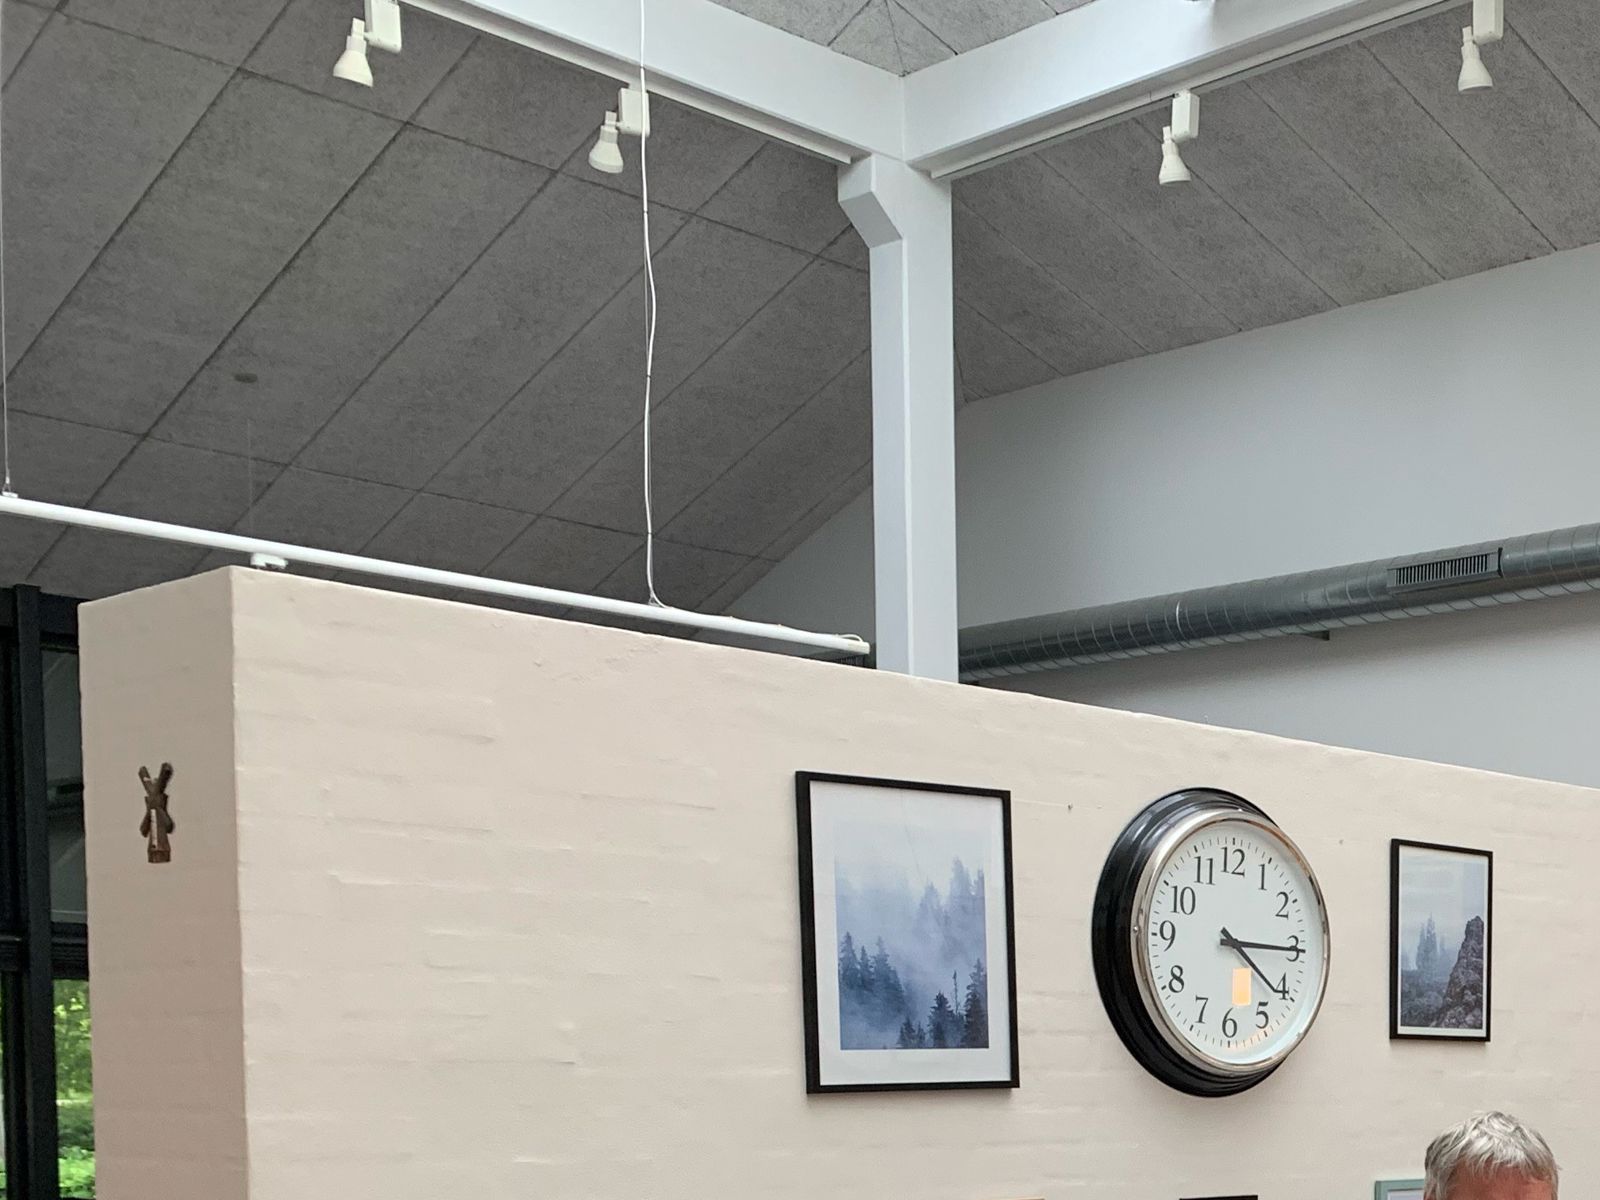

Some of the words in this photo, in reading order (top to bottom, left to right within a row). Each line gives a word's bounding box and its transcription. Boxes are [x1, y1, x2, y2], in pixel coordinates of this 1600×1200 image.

[1194, 855, 1216, 885] 11
[1221, 847, 1246, 877] 12
[1258, 863, 1268, 890] 1
[1170, 886, 1196, 915] 10
[1275, 891, 1290, 919] 2
[1159, 920, 1176, 951] 9
[1287, 935, 1300, 962] 3
[1168, 965, 1185, 993] 8
[1274, 972, 1289, 1000] 4
[1195, 995, 1209, 1024] 7
[1222, 1007, 1238, 1038] 6
[1255, 1001, 1269, 1029] 5
